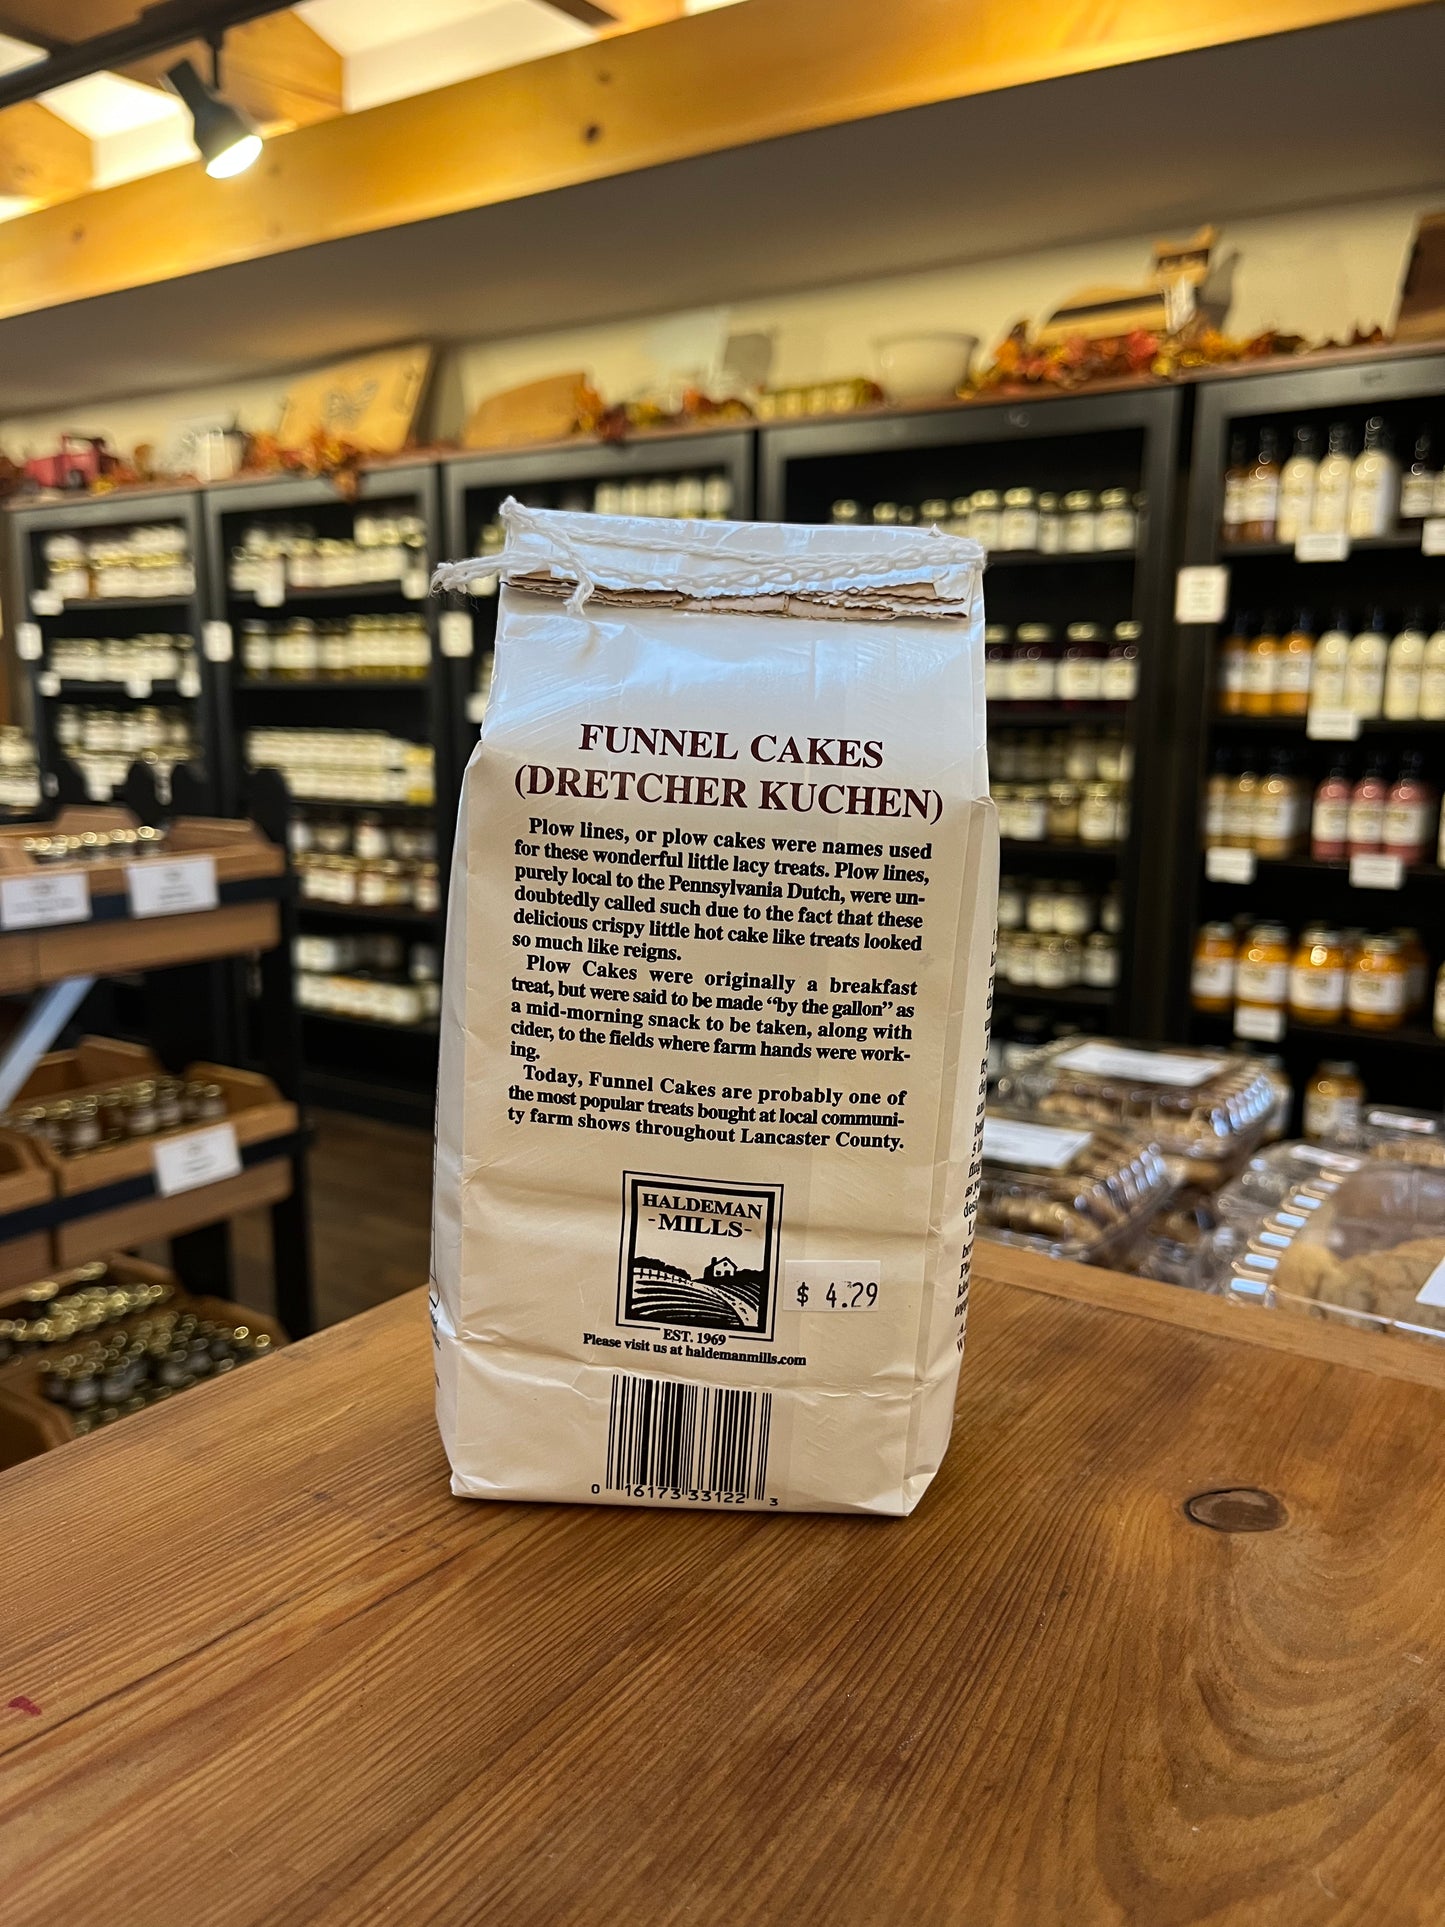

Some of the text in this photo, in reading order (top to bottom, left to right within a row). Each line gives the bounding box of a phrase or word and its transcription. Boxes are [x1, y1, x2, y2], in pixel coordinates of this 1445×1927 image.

[578, 724, 882, 768] FUNNEL CAKES
[515, 765, 942, 825] (DRETCHER KUCHEN)
[529, 818, 932, 859] Plow lines, or plow cakes were names used
[515, 839, 929, 886] for these wonderful little lacy treats. Plow lines,
[515, 866, 925, 905] purely local to the Pennsylvania Dutch, were un-
[515, 885, 923, 928] doubtedly called such due to the fact that these
[512, 935, 681, 962] so much like reigns.
[514, 908, 922, 951] delicious crispy little hot cake like treats looked
[526, 954, 918, 995] Plow Cakes were originally a breakfast
[512, 977, 554, 998] treat,
[558, 980, 586, 998] but
[590, 988, 630, 1002] were
[633, 988, 667, 1004] said
[671, 992, 688, 1006] to
[692, 992, 712, 1008] be
[716, 995, 763, 1011] made
[802, 999, 828, 1014] the
[896, 1006, 914, 1018] as
[511, 1001, 912, 1042] a mid-morning snack to be taken, along with
[511, 1020, 910, 1061] cider, to the fields where farm hands were work-
[510, 1041, 540, 1062] ing.
[508, 1085, 904, 1127] the most popular treats bought at local communi-
[523, 1065, 907, 1107] Today, Funnel Cakes are probably one of
[508, 1107, 904, 1152] ty farm shows throughout Lancaster County.
[642, 1193, 762, 1220] HALDEMAN
[796, 1281, 878, 1308] $ 4.29
[583, 1333, 806, 1365] Please visit us at haldemanmills.com
[663, 1328, 726, 1345] EST. 1969
[591, 1483, 600, 1494] 0
[769, 1497, 778, 1506] 3
